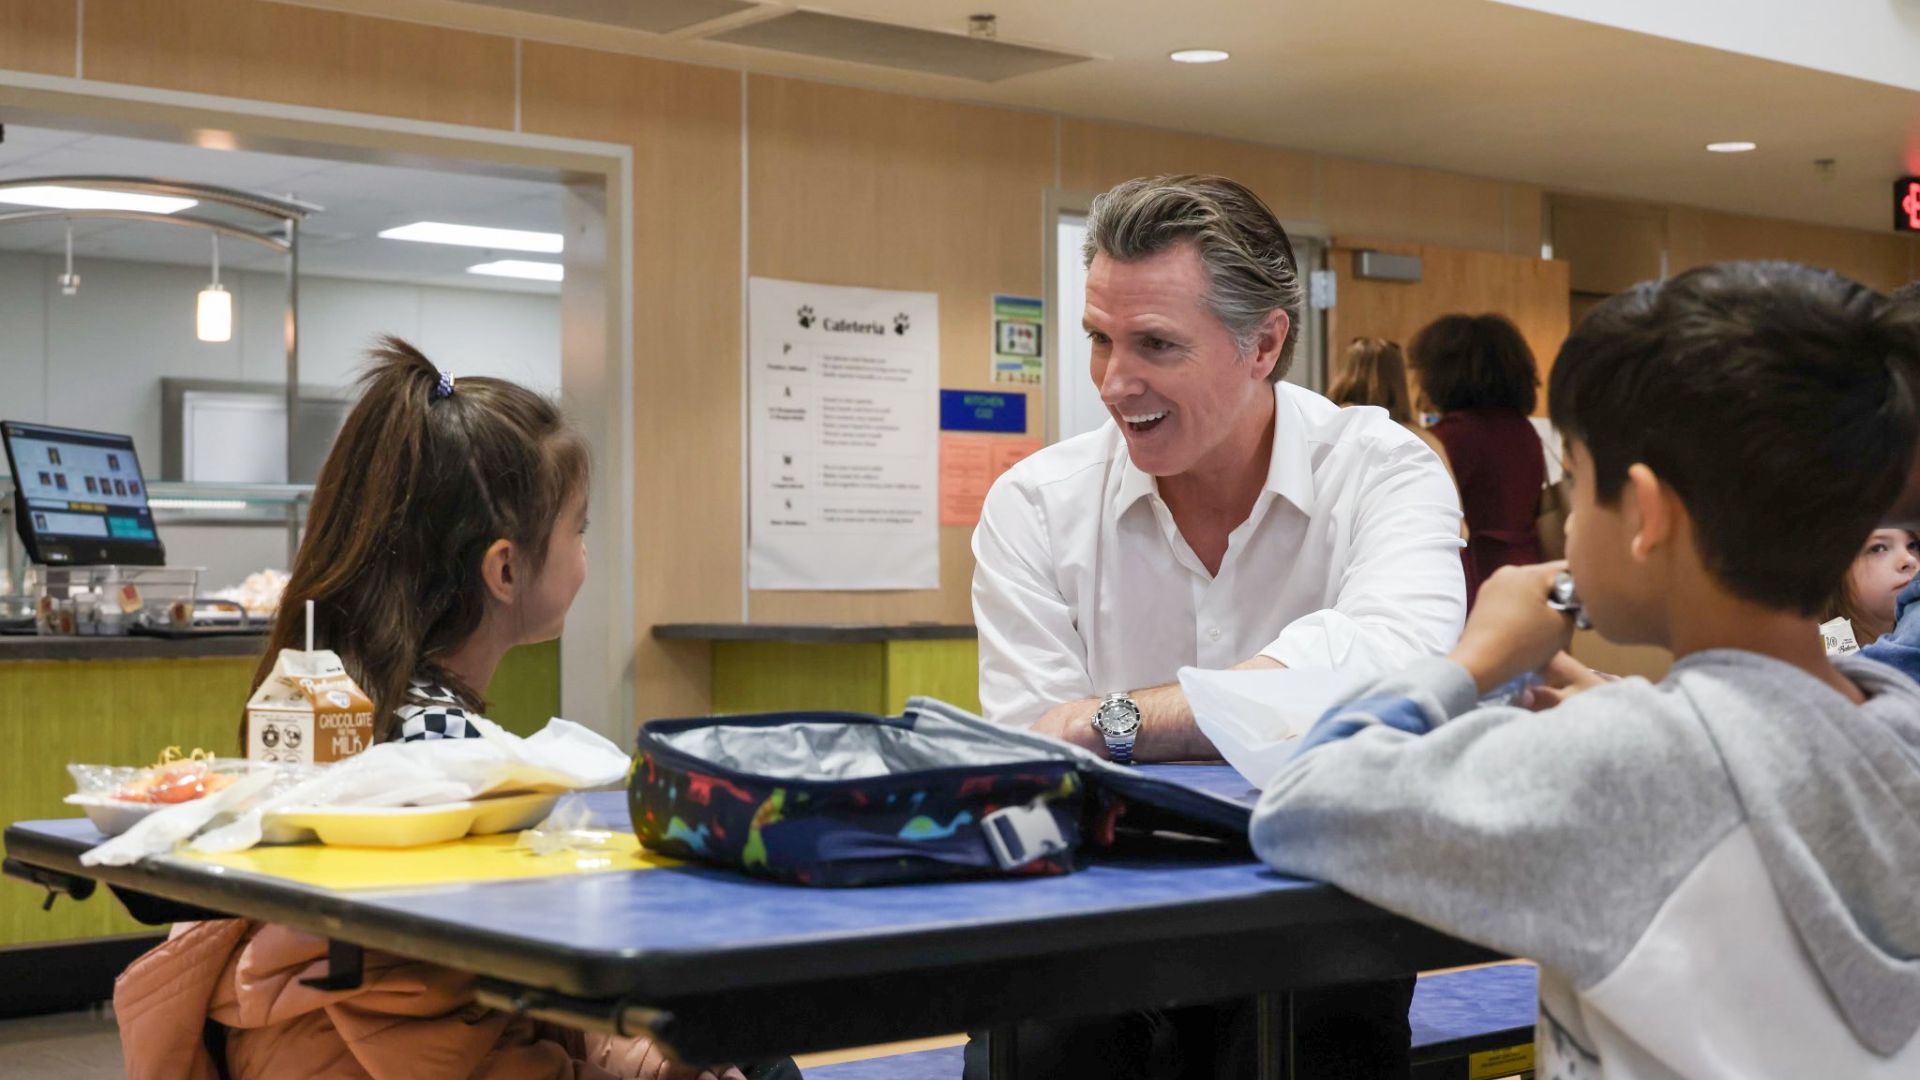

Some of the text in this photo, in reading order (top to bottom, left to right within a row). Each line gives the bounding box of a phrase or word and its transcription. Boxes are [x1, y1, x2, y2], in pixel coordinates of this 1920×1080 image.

[823, 317, 885, 335] Cafeteria
[319, 712, 373, 729] CHOCOLATE
[332, 735, 363, 756] MILK
